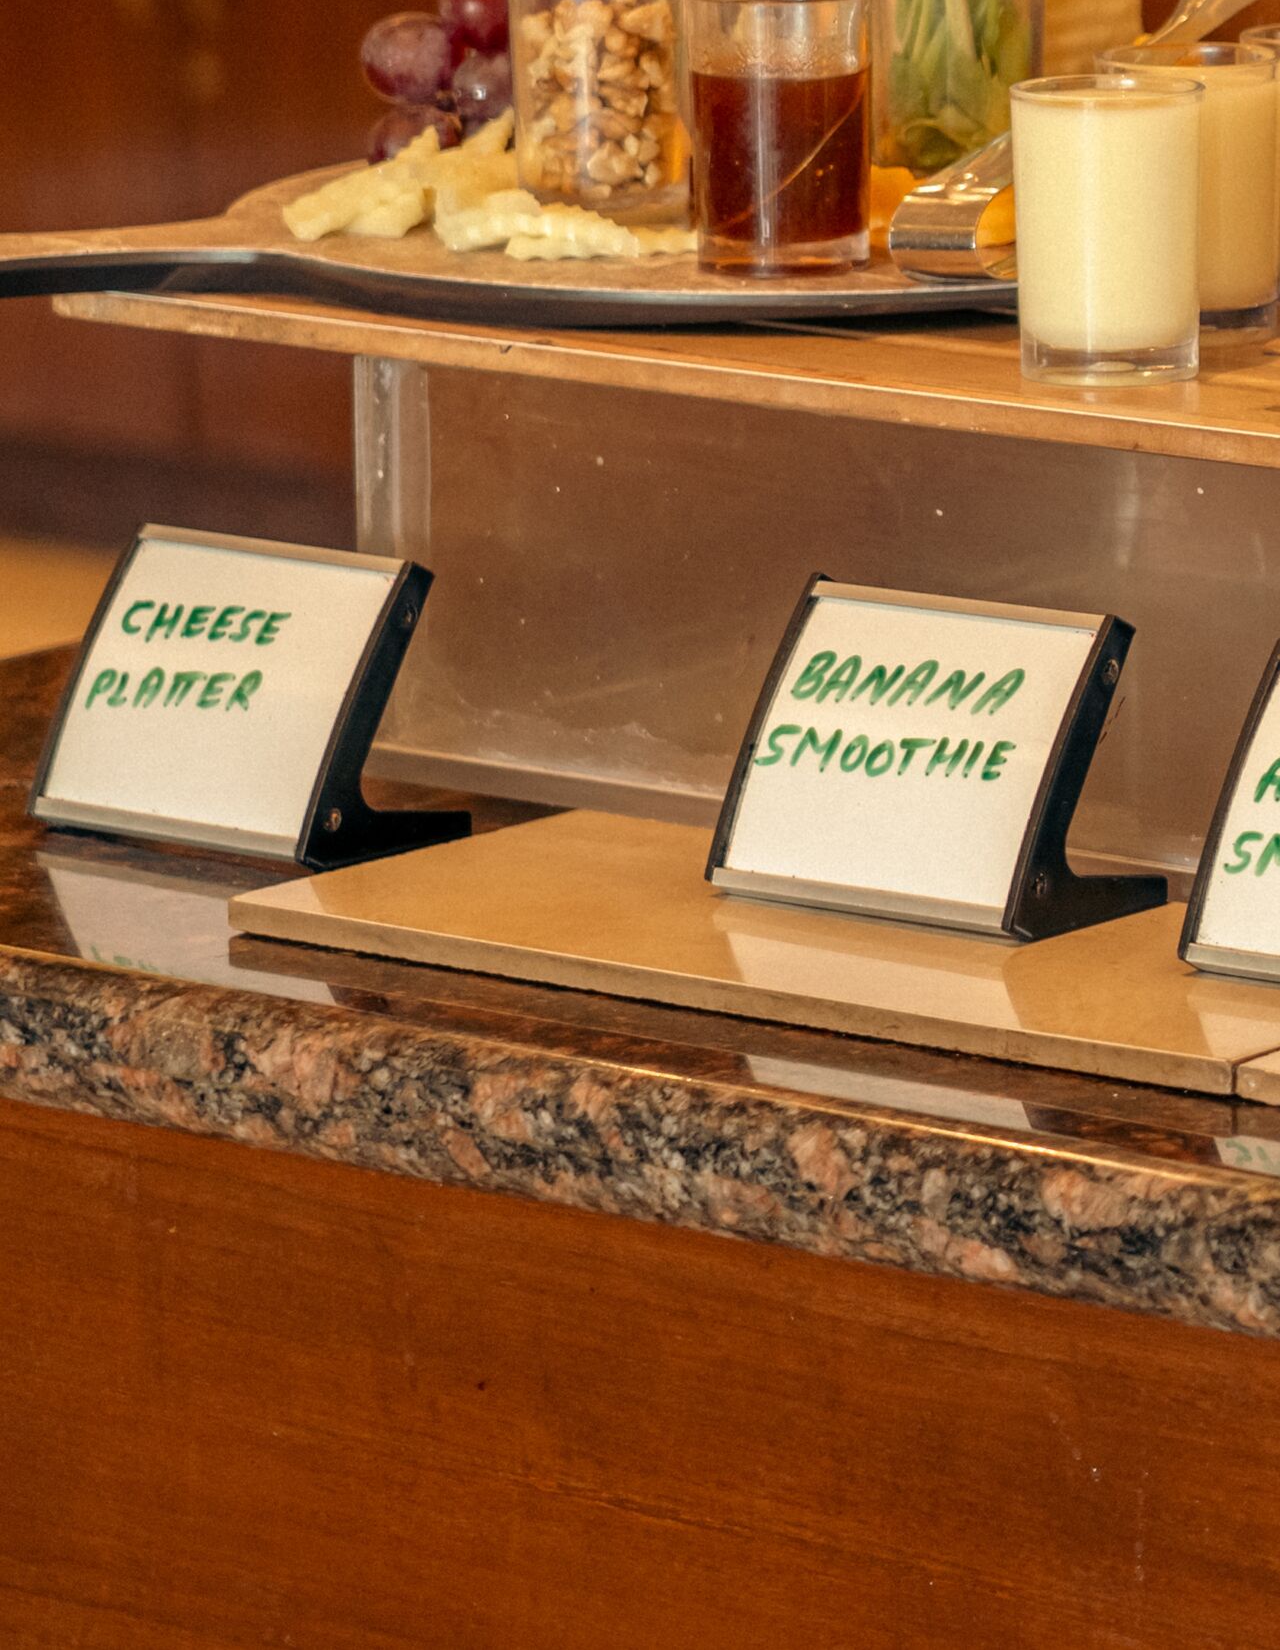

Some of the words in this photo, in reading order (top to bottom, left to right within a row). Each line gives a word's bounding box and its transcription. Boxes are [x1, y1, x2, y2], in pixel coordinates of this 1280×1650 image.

[120, 600, 292, 646] CHEESE
[84, 666, 265, 711] PLATTER
[791, 650, 1026, 715] BANANA
[752, 724, 1017, 782] SMOOTHIE
